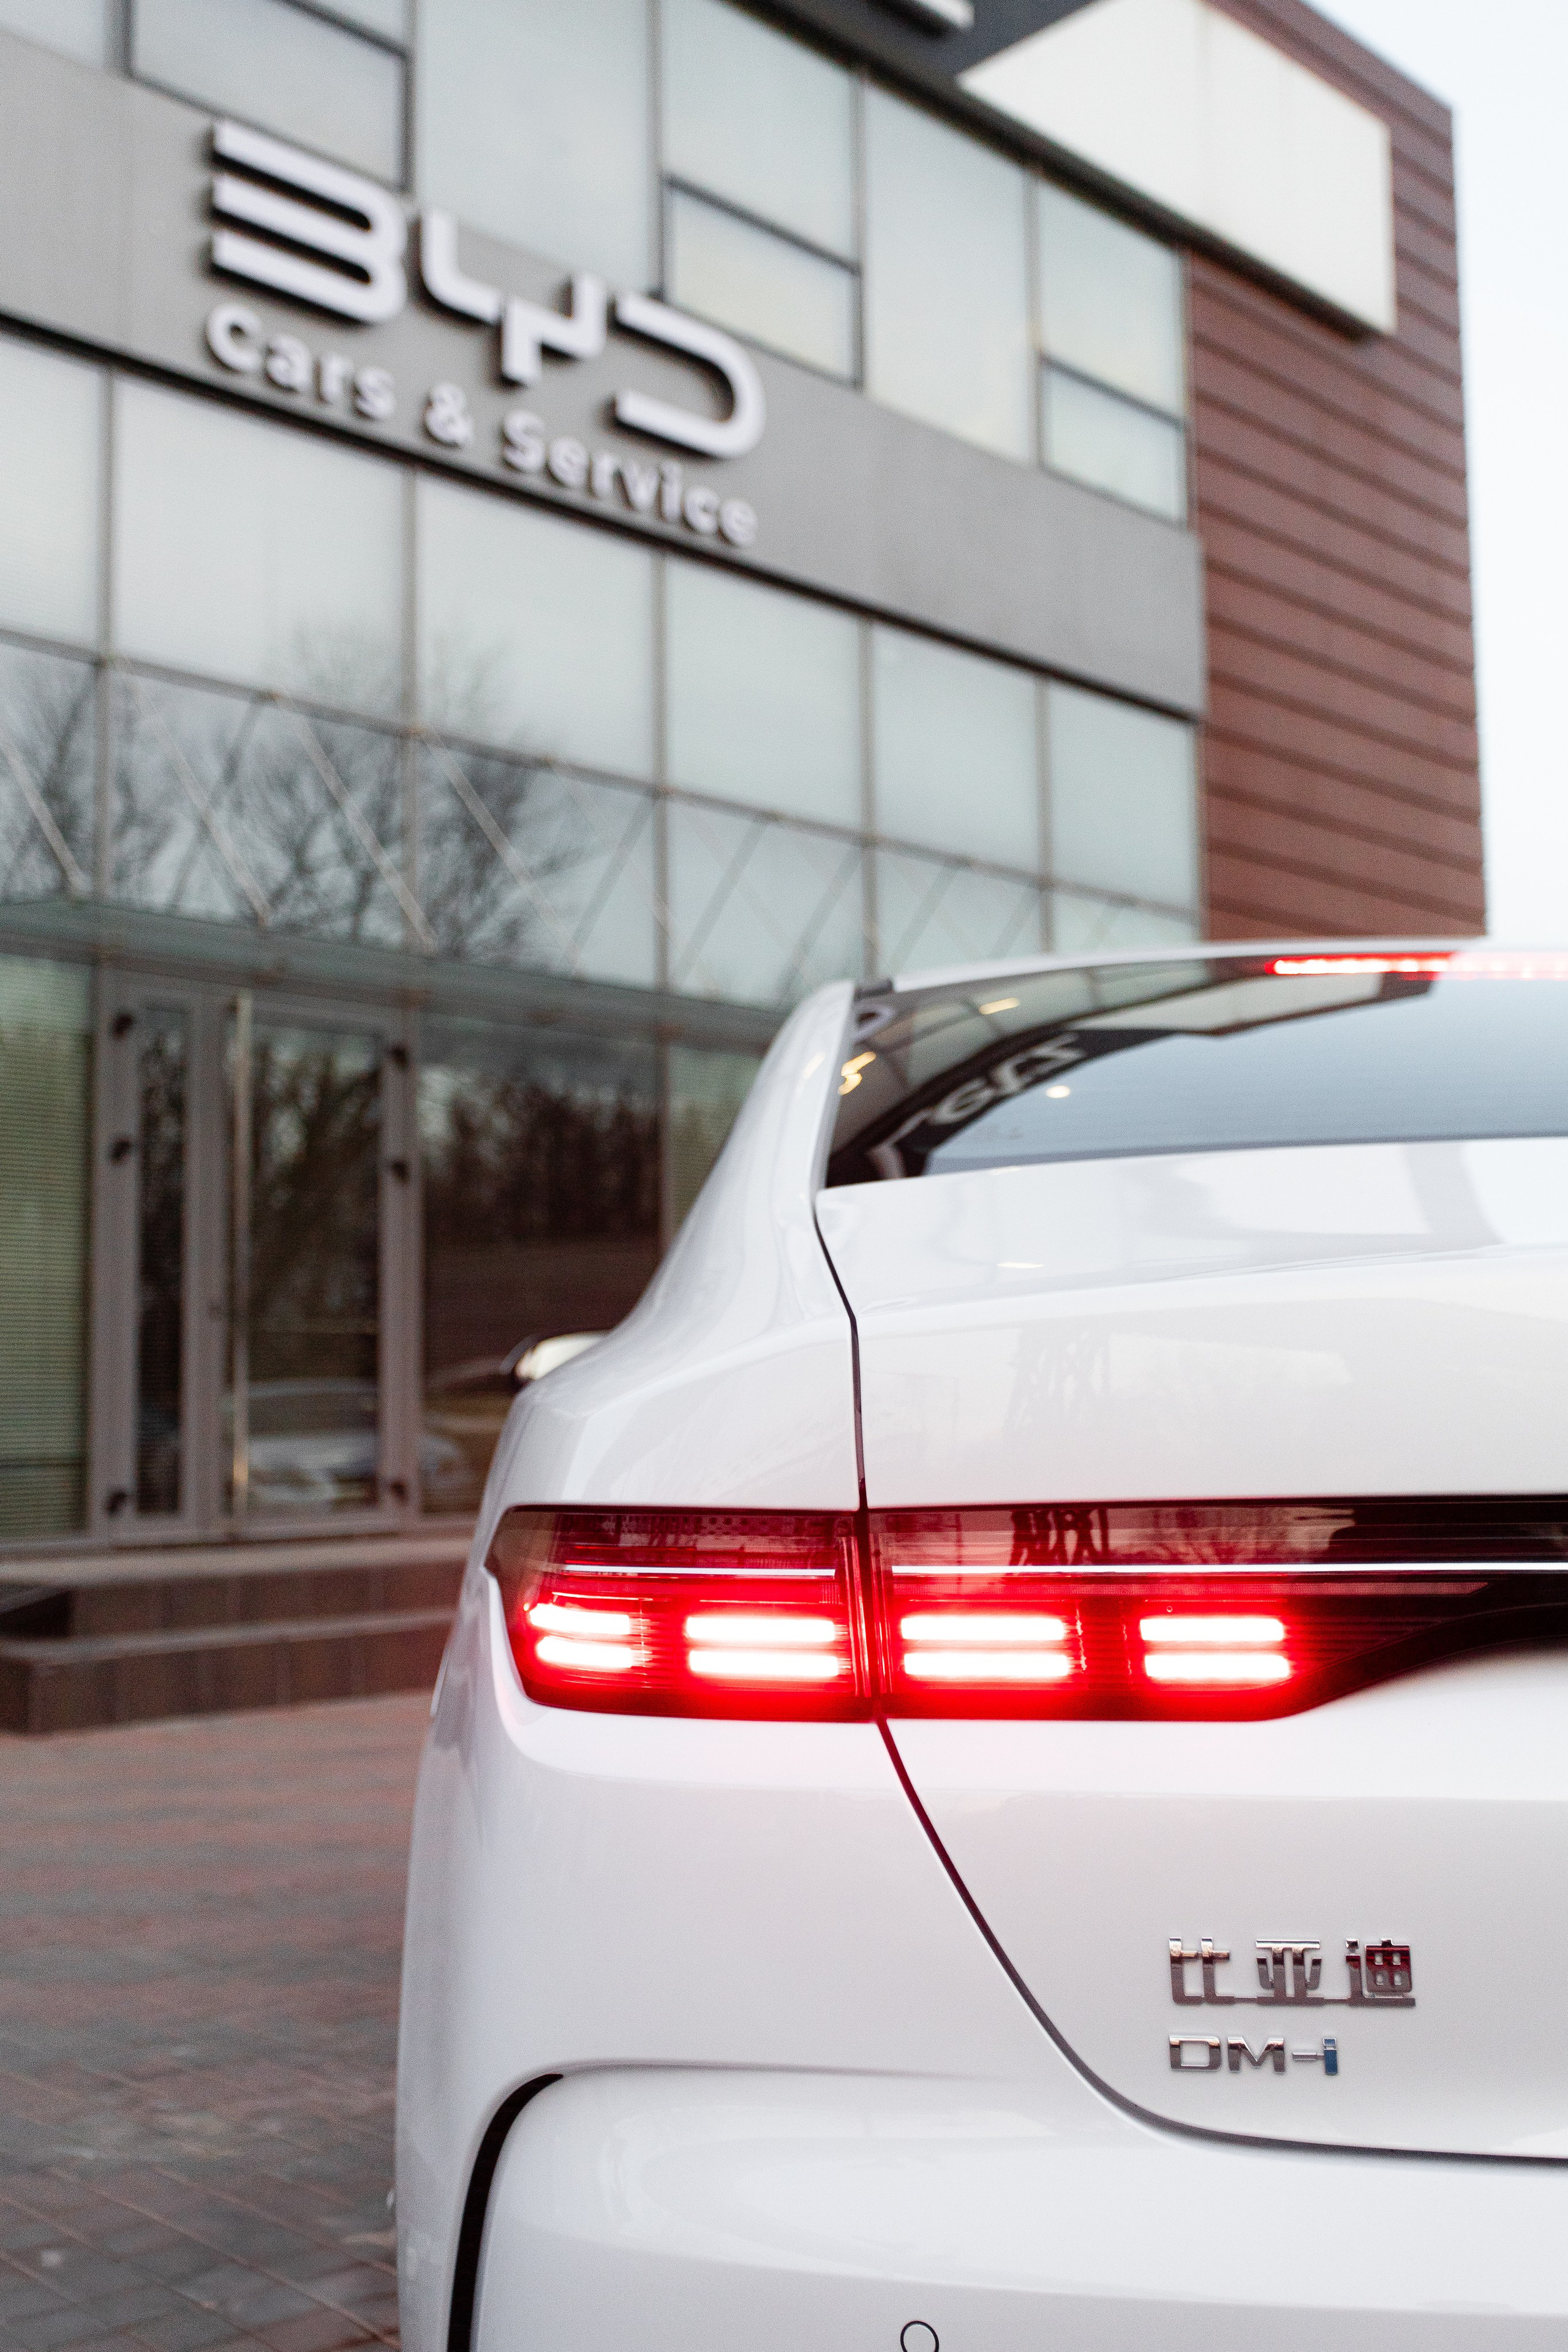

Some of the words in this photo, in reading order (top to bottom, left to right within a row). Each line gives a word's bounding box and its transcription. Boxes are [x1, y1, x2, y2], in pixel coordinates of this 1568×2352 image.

[213, 120, 765, 459] BYD
[423, 382, 472, 447] &
[502, 410, 758, 546] Service
[1169, 1937, 1416, 2007] 比亚迪
[1169, 2034, 1338, 2075] DM-i
